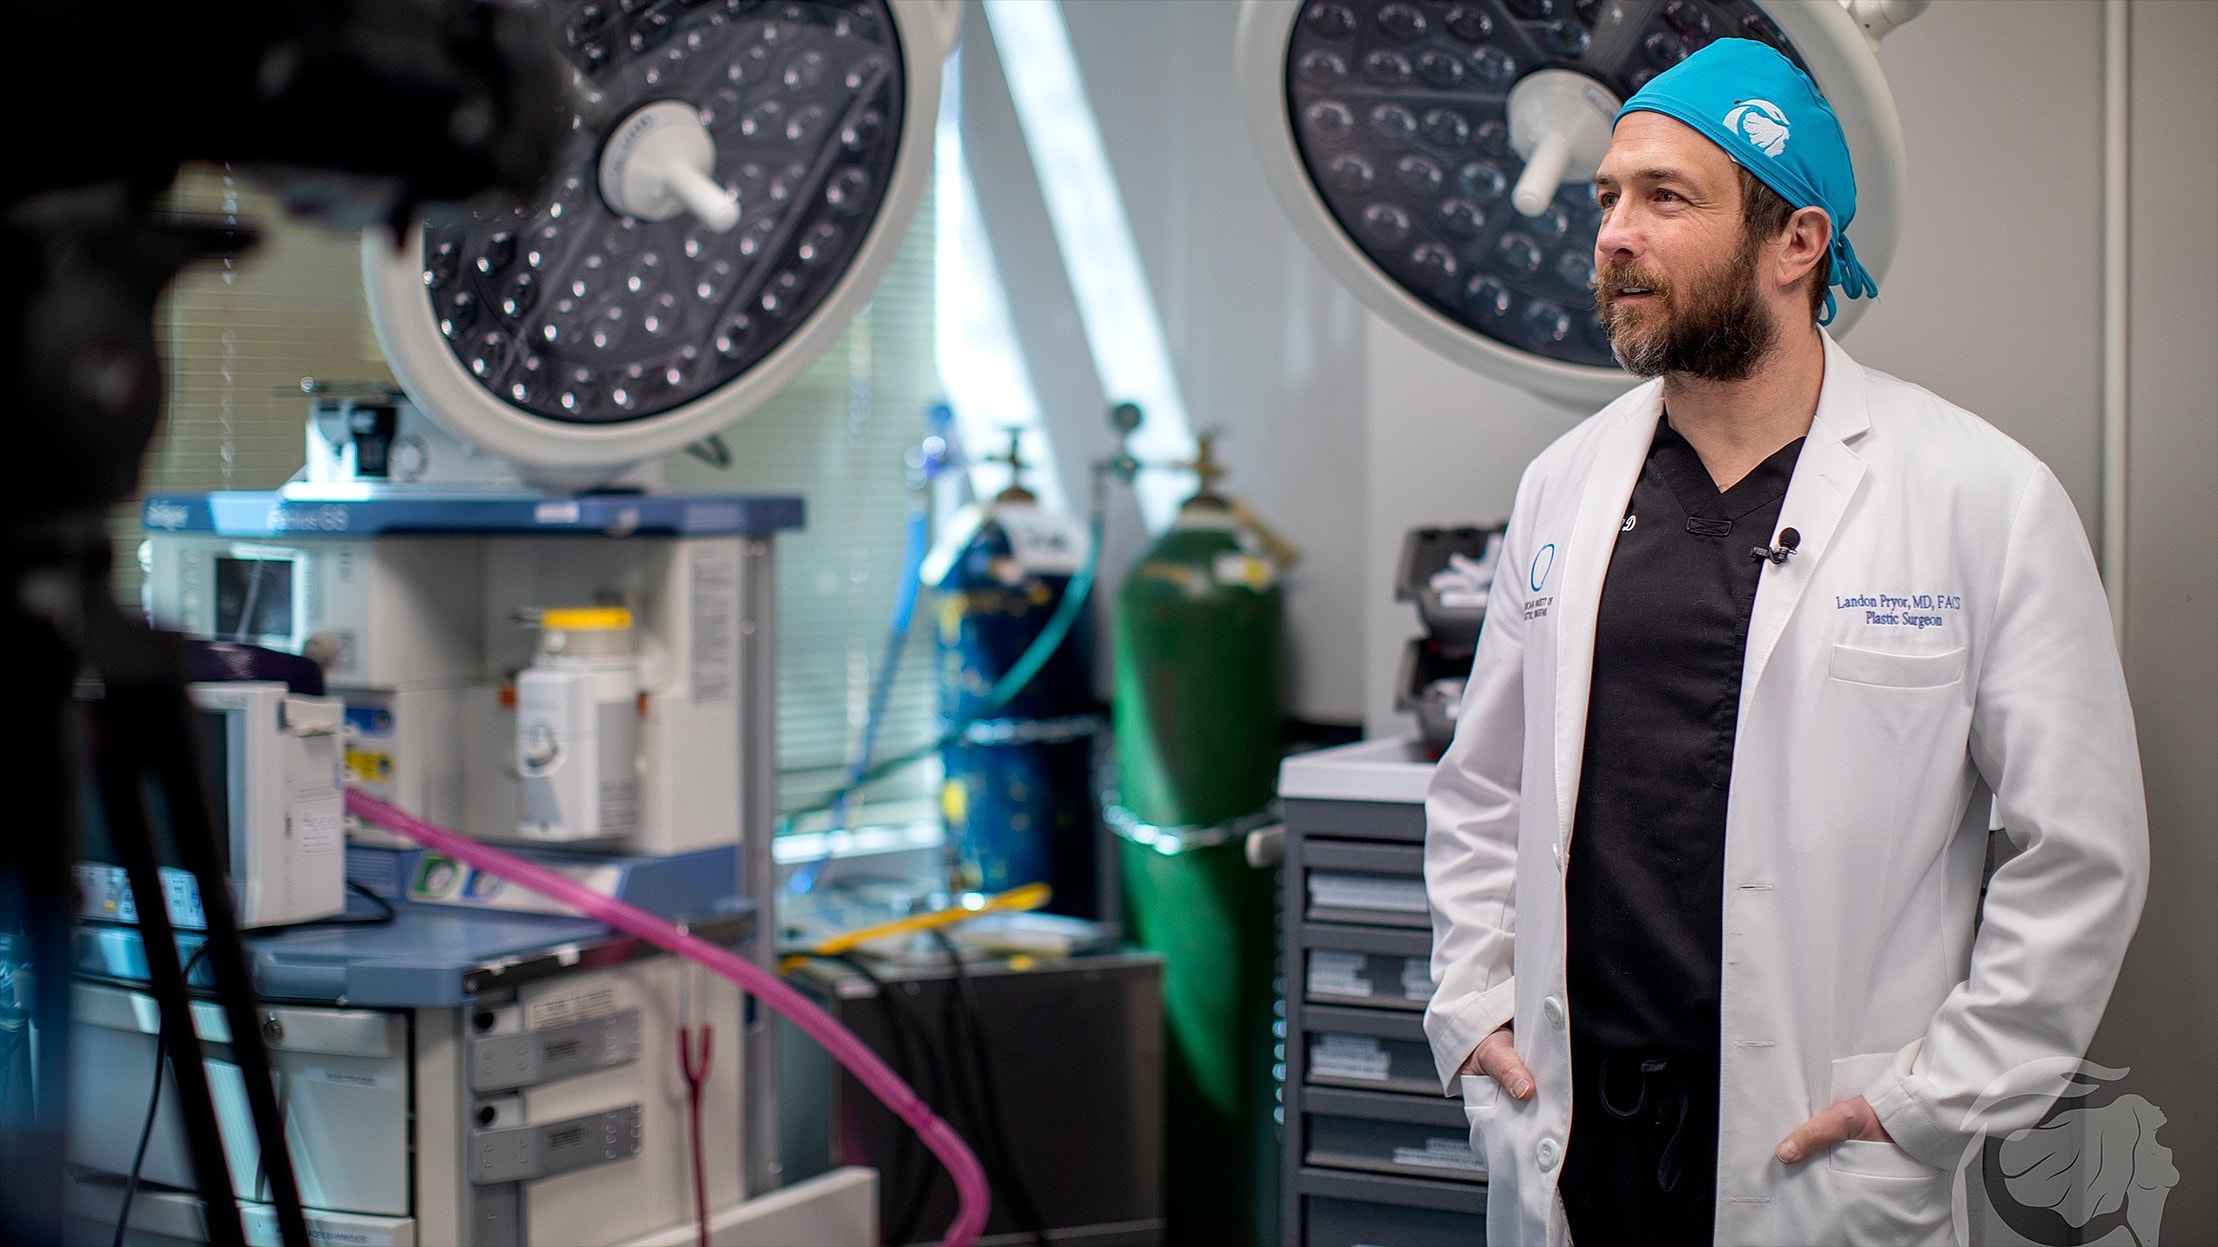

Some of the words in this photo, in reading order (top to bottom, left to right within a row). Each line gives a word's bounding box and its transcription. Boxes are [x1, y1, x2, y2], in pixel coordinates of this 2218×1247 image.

[1835, 594, 1877, 609] Landon
[1880, 594, 1911, 611] Pryor,
[1912, 595, 1935, 611] MD,
[1866, 611, 1899, 625] Plastic
[1902, 612, 1943, 629] Surgeon
